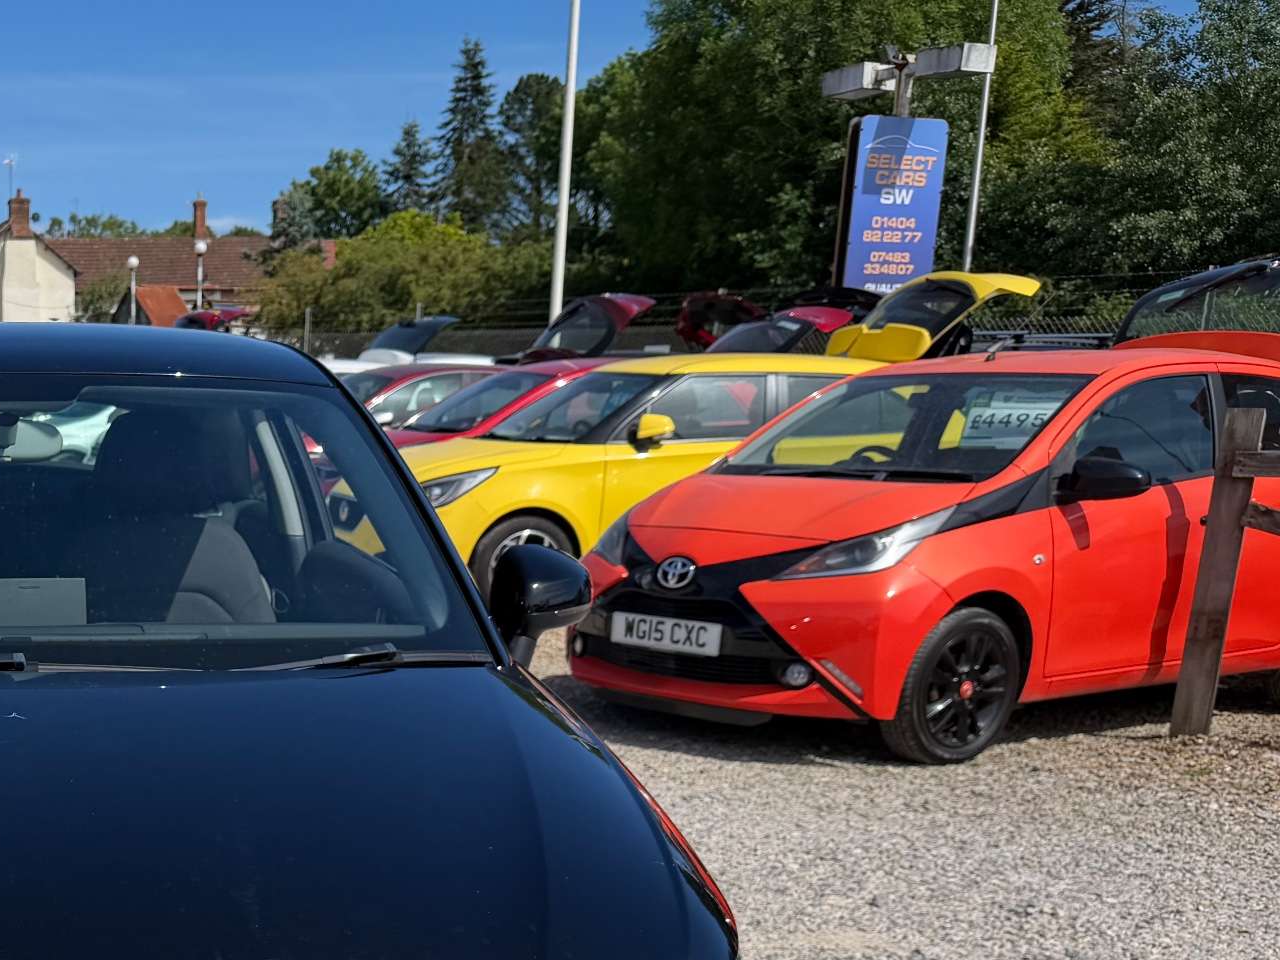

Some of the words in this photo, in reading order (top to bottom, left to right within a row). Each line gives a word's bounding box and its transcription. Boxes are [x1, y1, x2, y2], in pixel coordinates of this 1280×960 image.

[866, 153, 937, 171] SELECT
[875, 170, 928, 188] CARS
[879, 188, 914, 205] SW
[871, 216, 916, 229] 01404
[970, 412, 1048, 430] £4495
[624, 616, 666, 642] WG15
[670, 622, 707, 648] CXC
